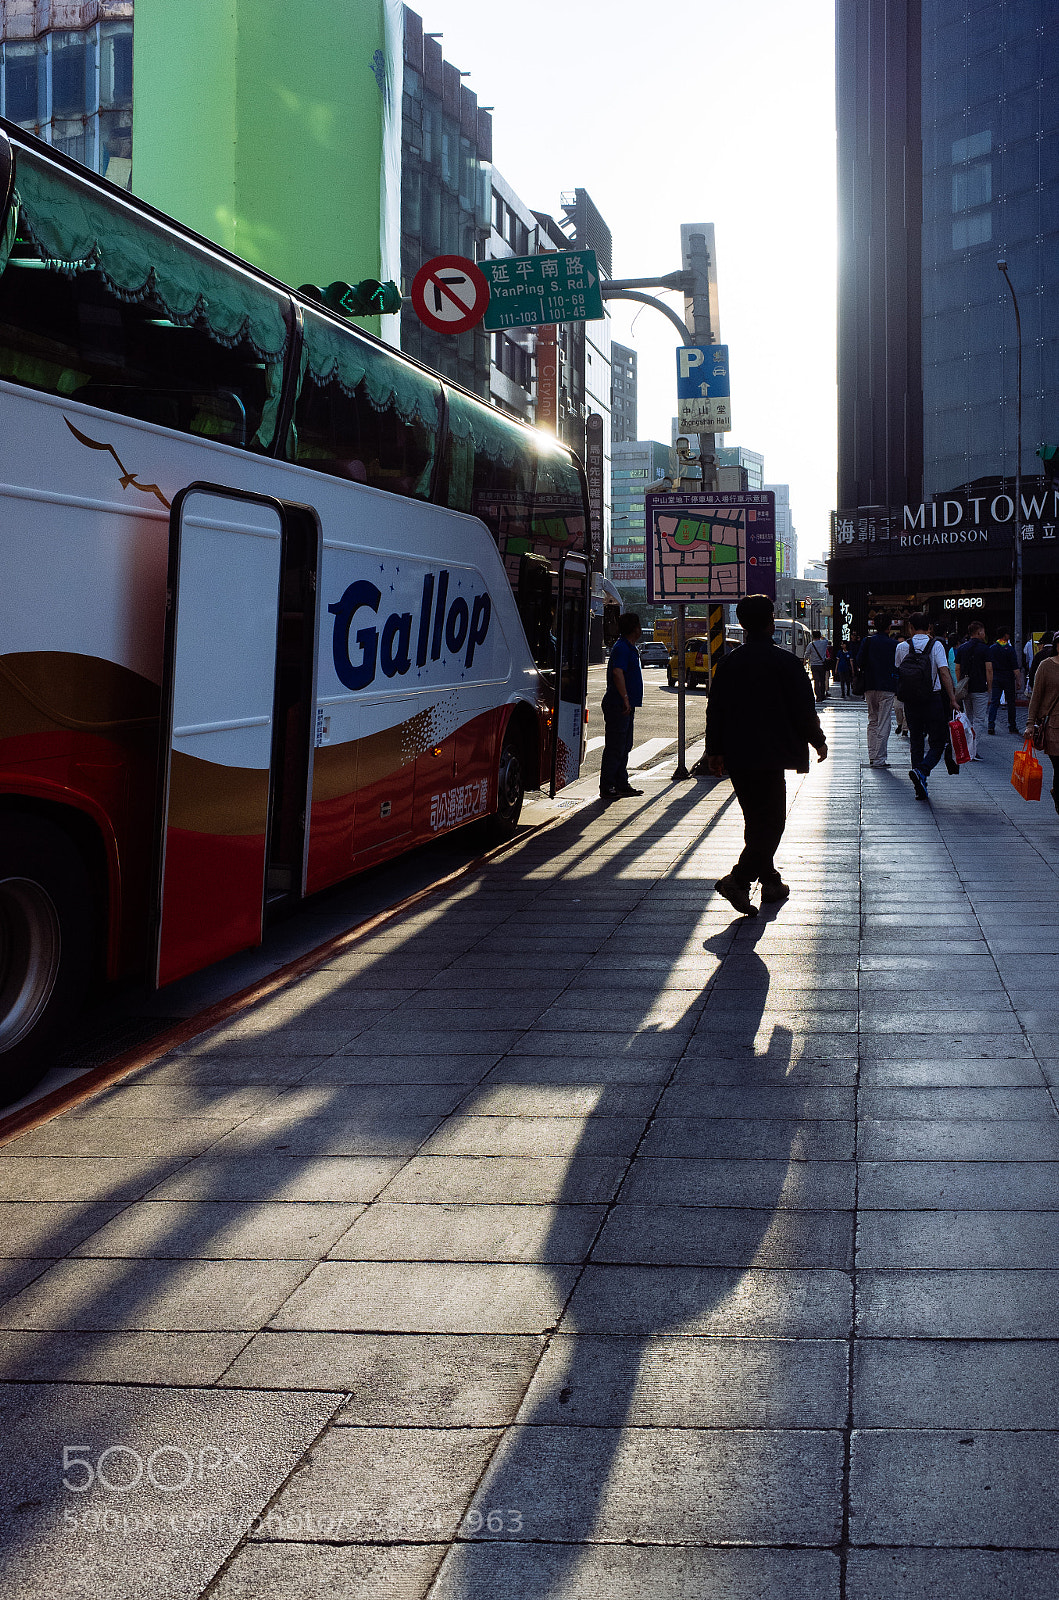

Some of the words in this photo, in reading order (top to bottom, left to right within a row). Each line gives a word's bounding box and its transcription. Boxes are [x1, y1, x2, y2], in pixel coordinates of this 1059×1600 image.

[491, 256, 584, 283] 延平南路
[494, 284, 545, 298] YanPing
[550, 281, 562, 292] S.
[567, 279, 587, 290] Rd.
[548, 294, 585, 307] 110-68
[500, 311, 537, 325] 111-103
[549, 306, 586, 320] 101-45
[679, 348, 705, 378] P
[682, 405, 727, 415] 中山堂
[680, 418, 715, 427] Zhongshan
[716, 417, 730, 425] Hall
[903, 490, 1059, 530] MIDTOW
[900, 529, 988, 547] RICHARDSON
[1021, 522, 1057, 541] 德立
[327, 570, 491, 691] Gallop
